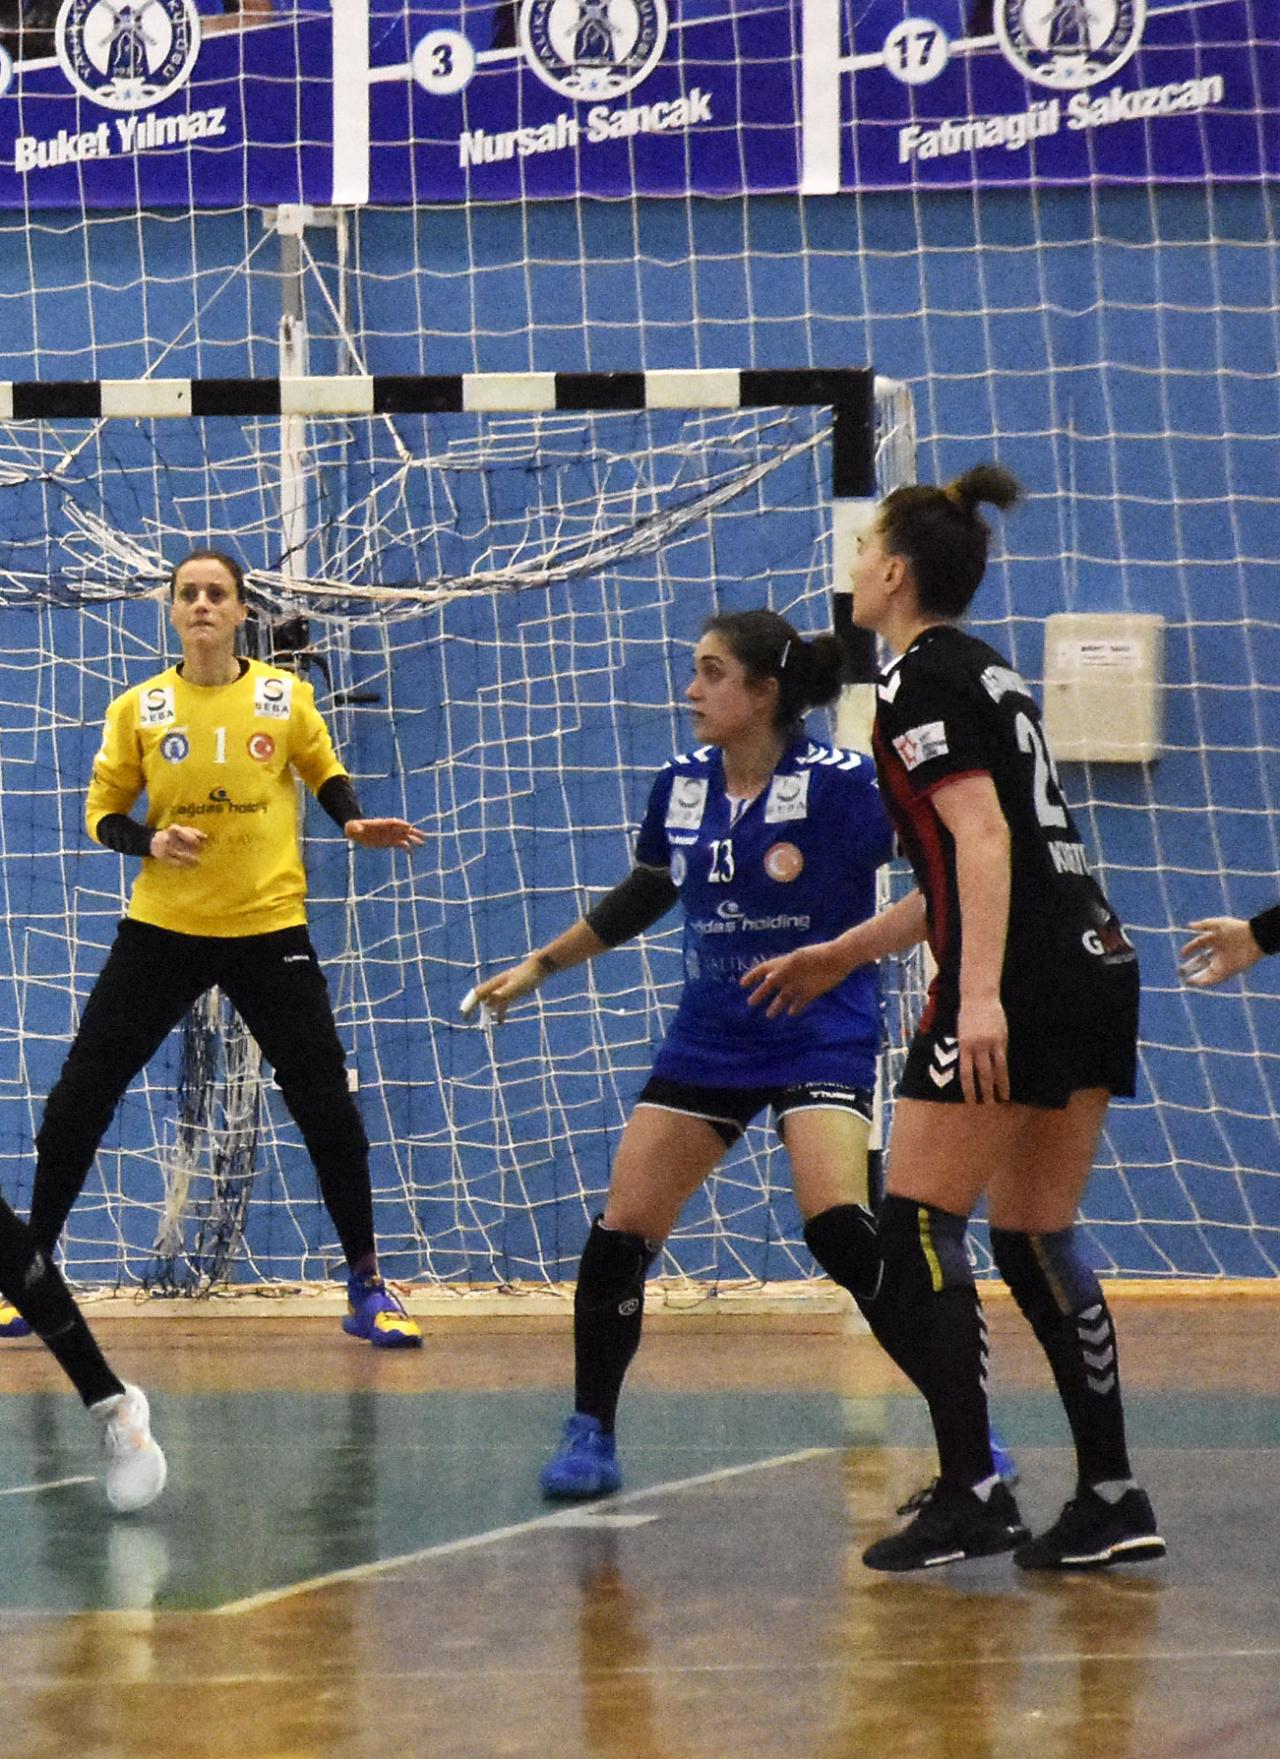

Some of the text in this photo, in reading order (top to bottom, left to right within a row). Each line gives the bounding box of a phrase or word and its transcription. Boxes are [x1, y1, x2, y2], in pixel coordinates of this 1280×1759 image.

[431, 44, 453, 77] 3
[893, 30, 937, 69] 17
[587, 87, 714, 143] Sancak
[898, 99, 1060, 164] Fatmagül
[15, 107, 227, 173] Buket Yılmaz
[141, 710, 175, 723] SEBA
[254, 702, 289, 713] SEBA
[214, 726, 228, 765] 1
